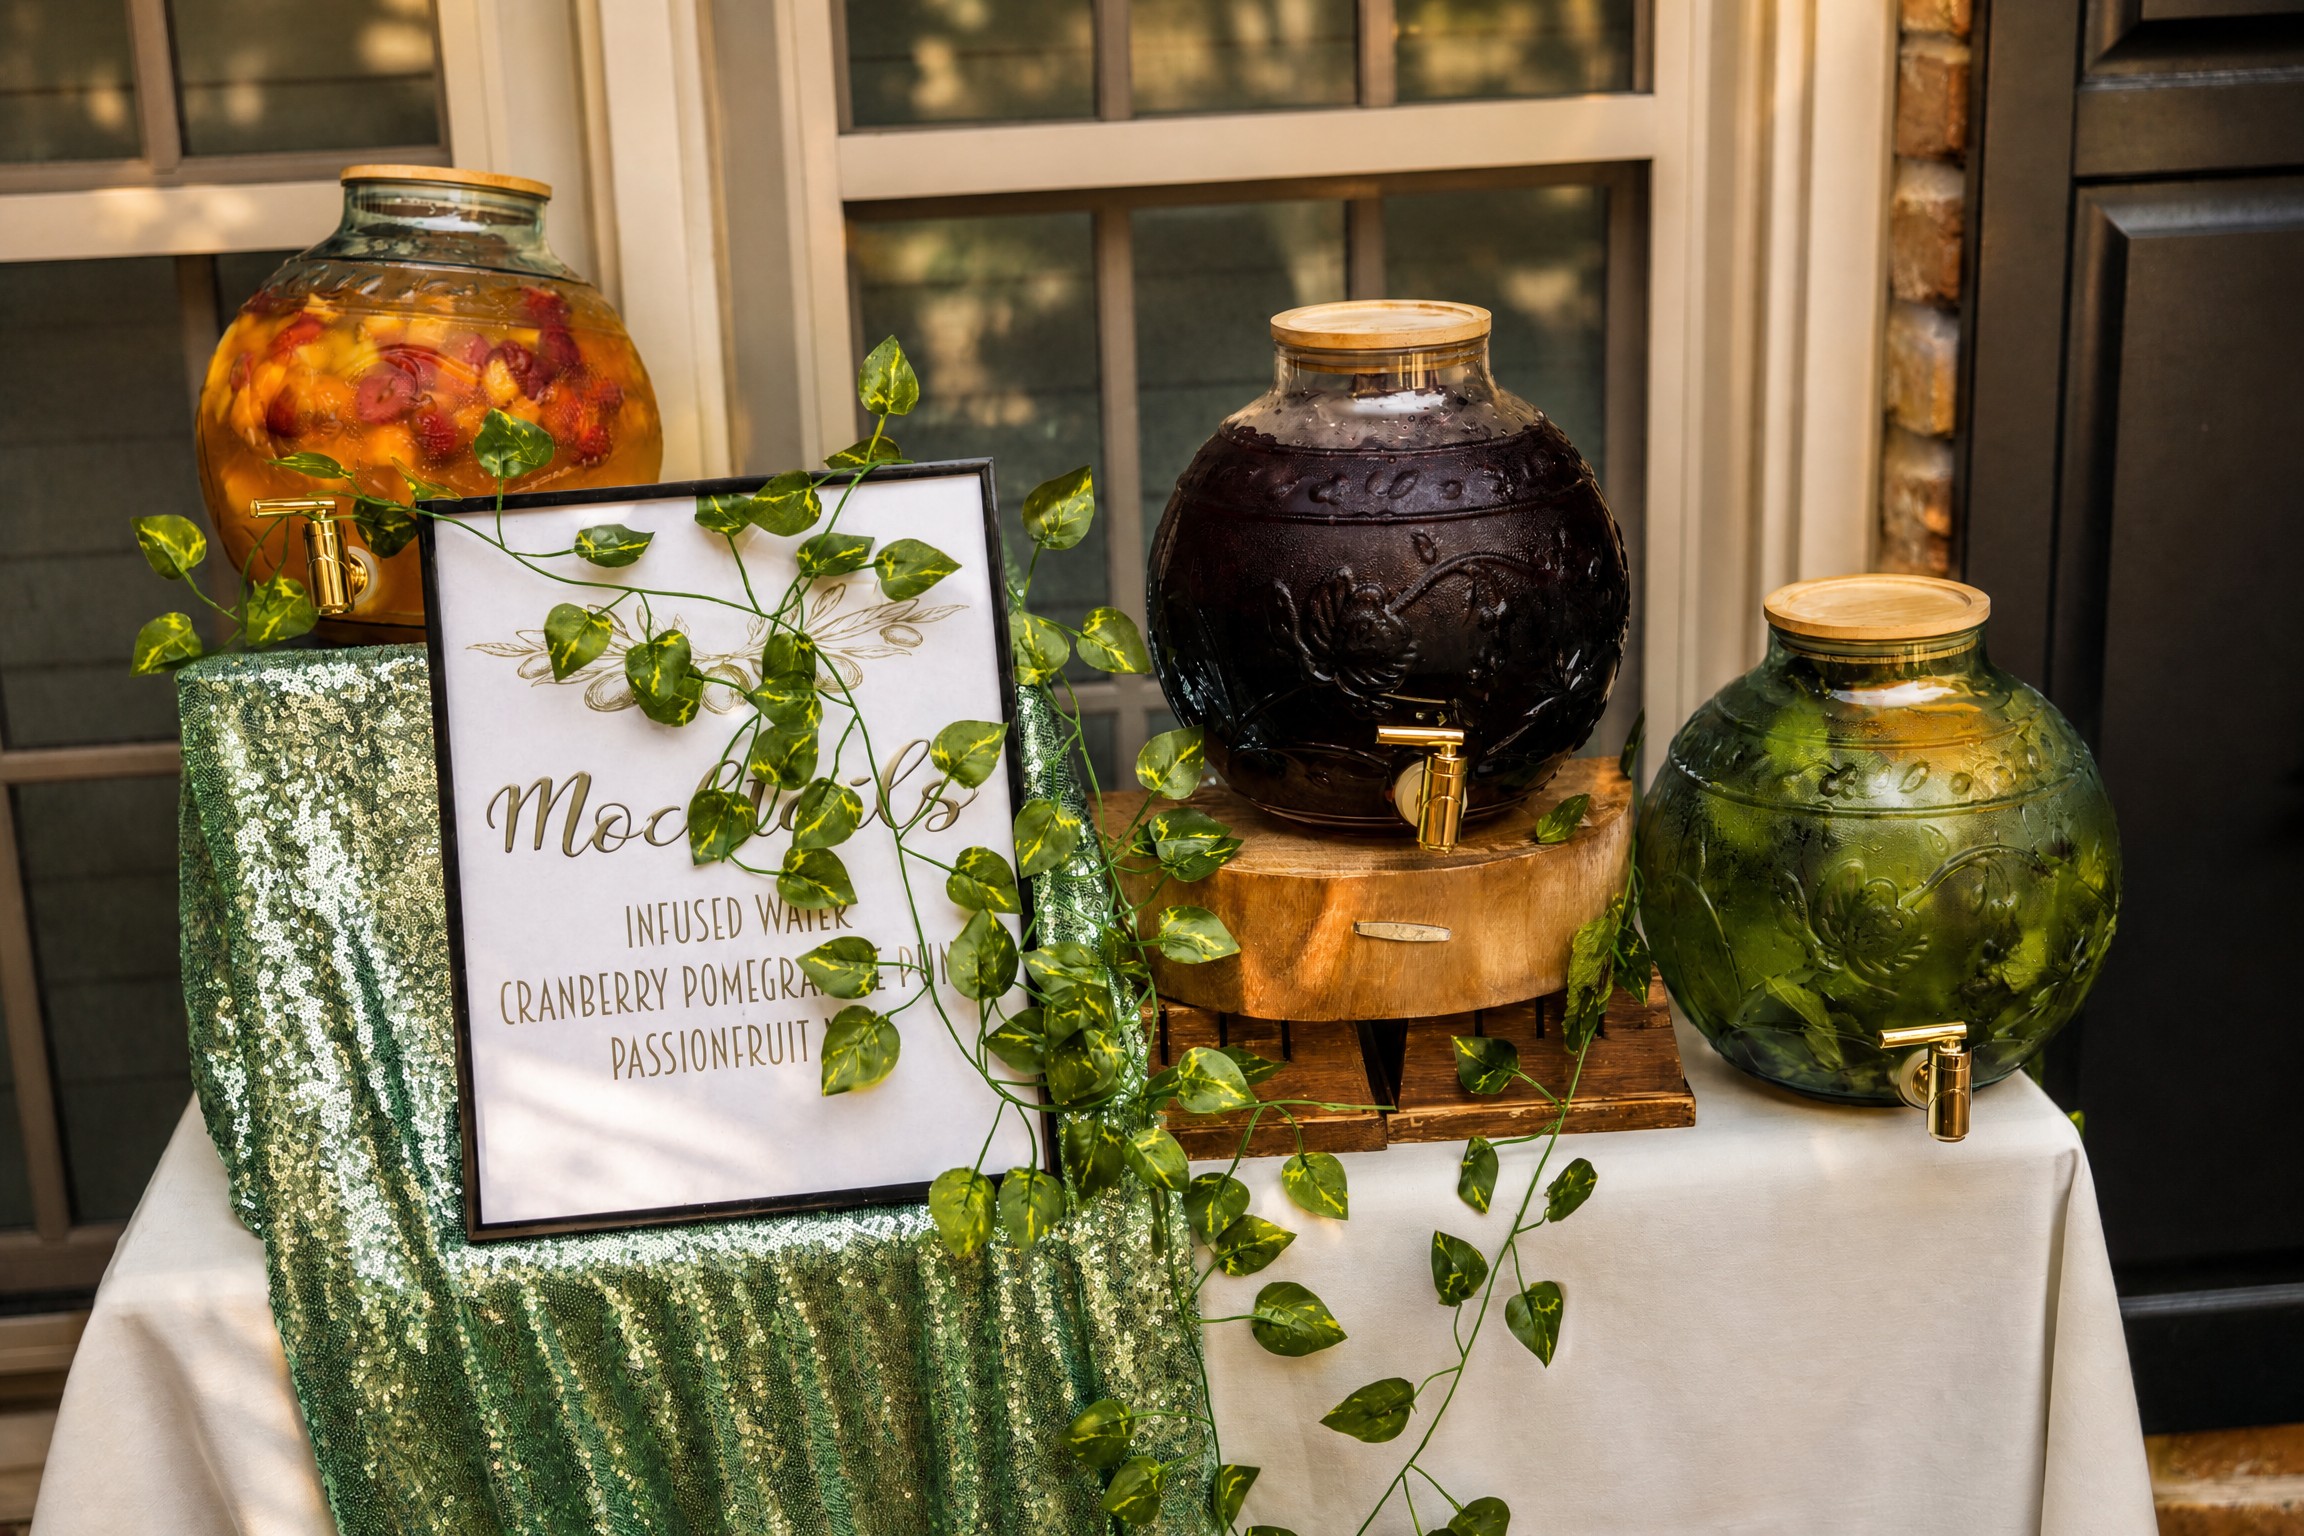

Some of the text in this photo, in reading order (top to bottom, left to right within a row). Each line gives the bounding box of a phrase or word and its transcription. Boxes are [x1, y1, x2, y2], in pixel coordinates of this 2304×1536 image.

[625, 896, 743, 949] INFUSED
[499, 967, 668, 1026] CRANBERRY
[682, 946, 886, 1008] POMEGRAE
[610, 1019, 810, 1081] PASSIONFRUIT
